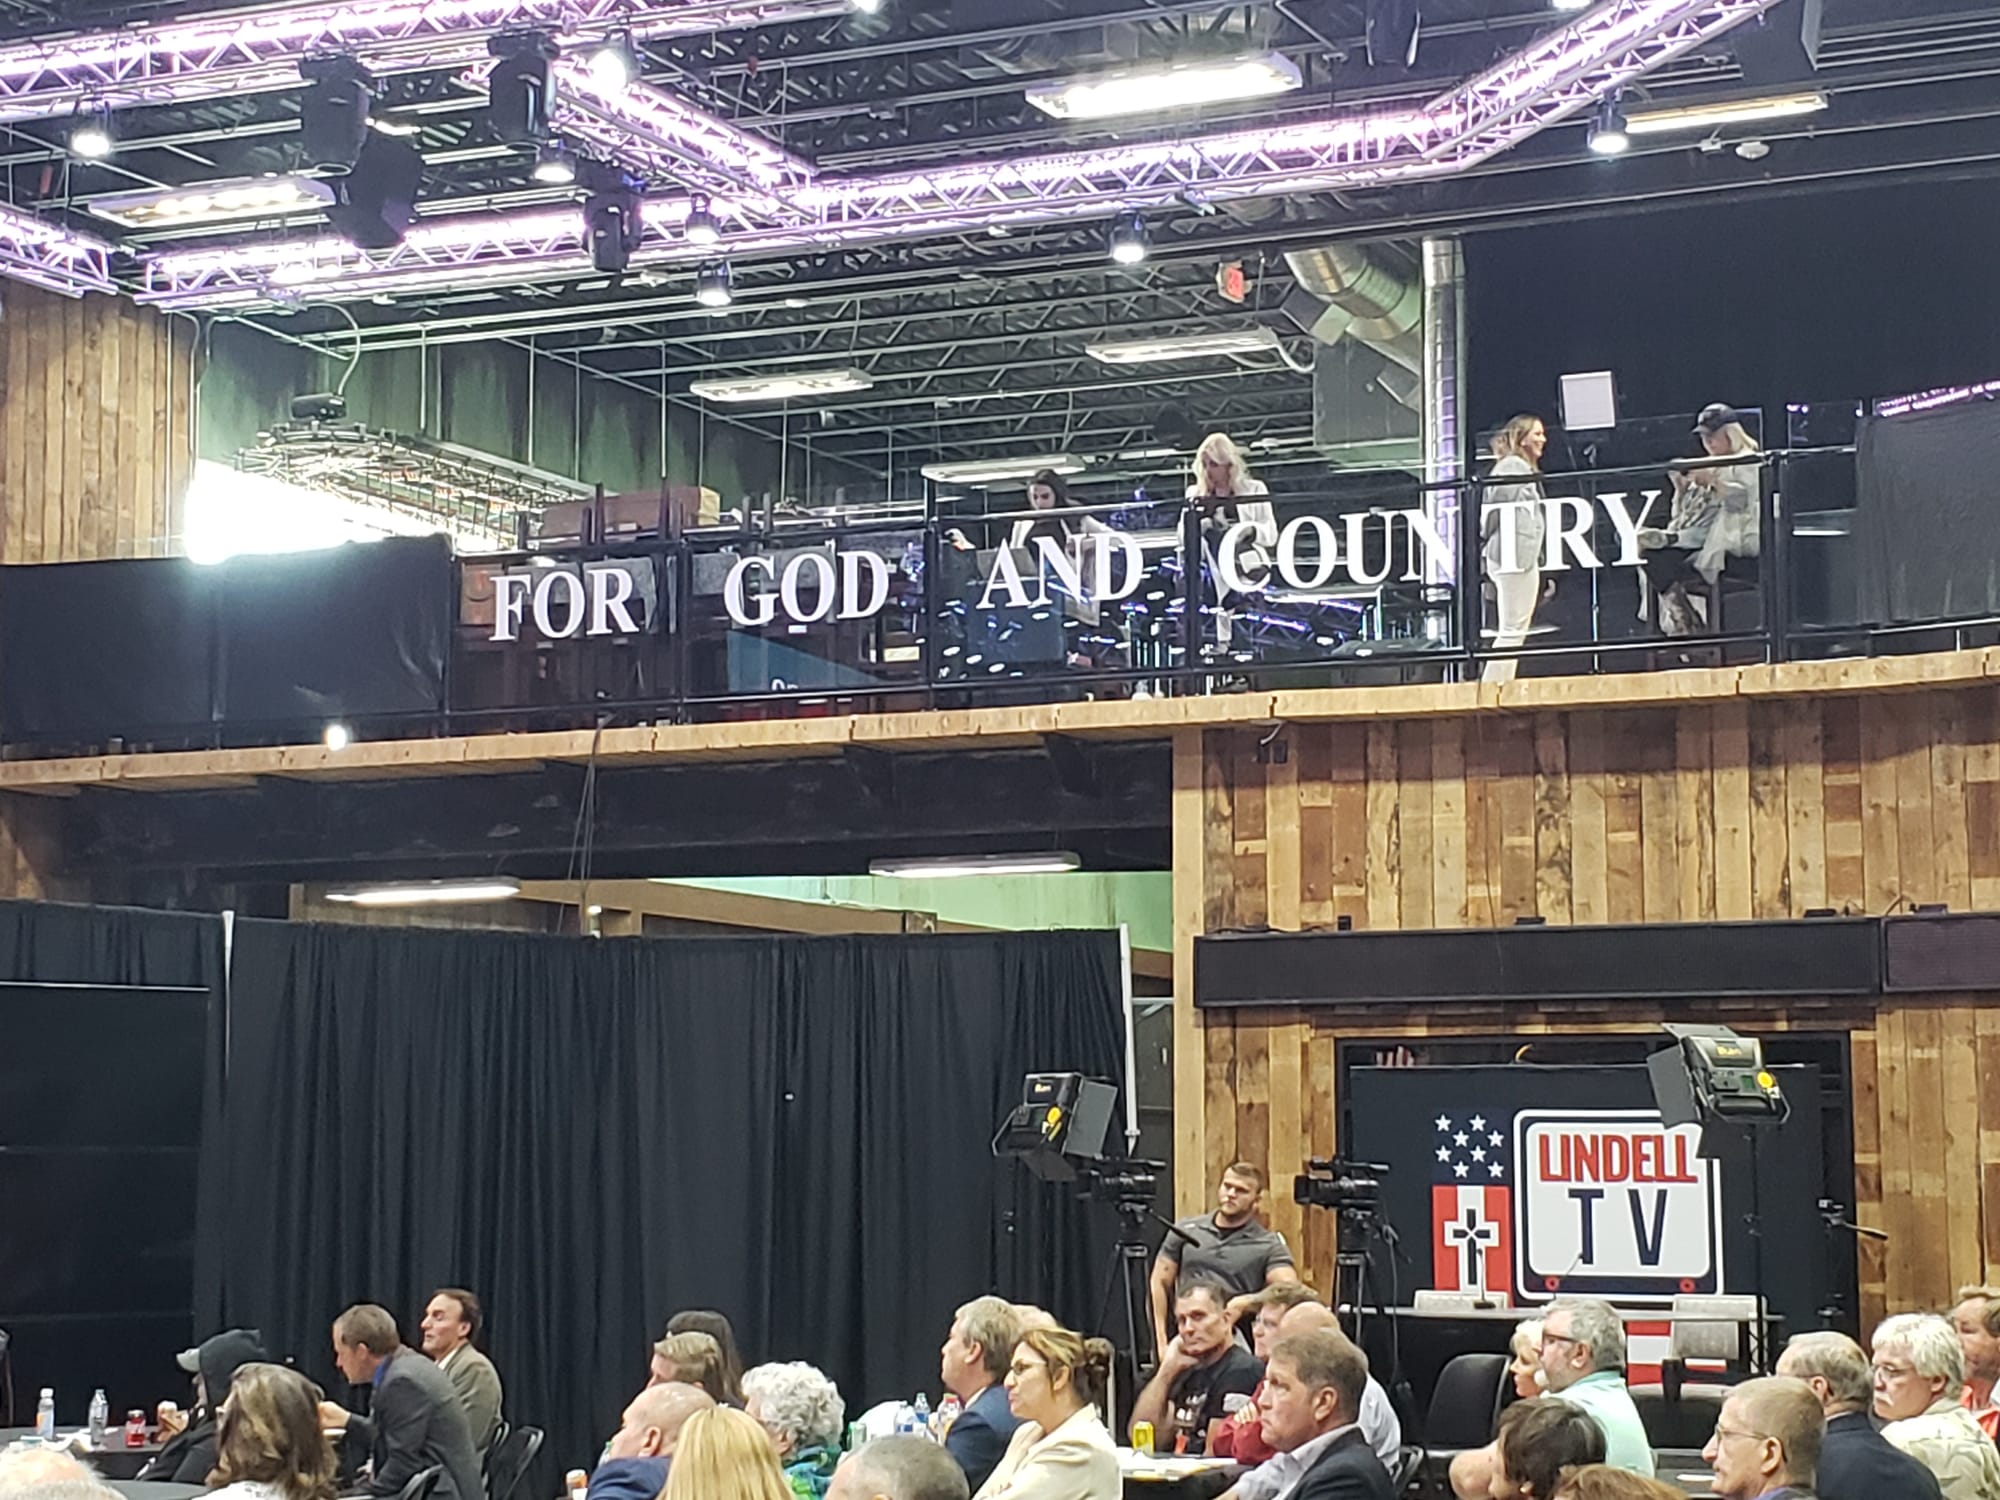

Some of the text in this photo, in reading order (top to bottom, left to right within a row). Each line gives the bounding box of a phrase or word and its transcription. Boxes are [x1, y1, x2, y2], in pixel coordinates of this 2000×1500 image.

[488, 568, 640, 643] FOR
[723, 550, 890, 627] GOD
[975, 531, 1144, 610] AND
[1538, 1133, 1699, 1184] LINDELL
